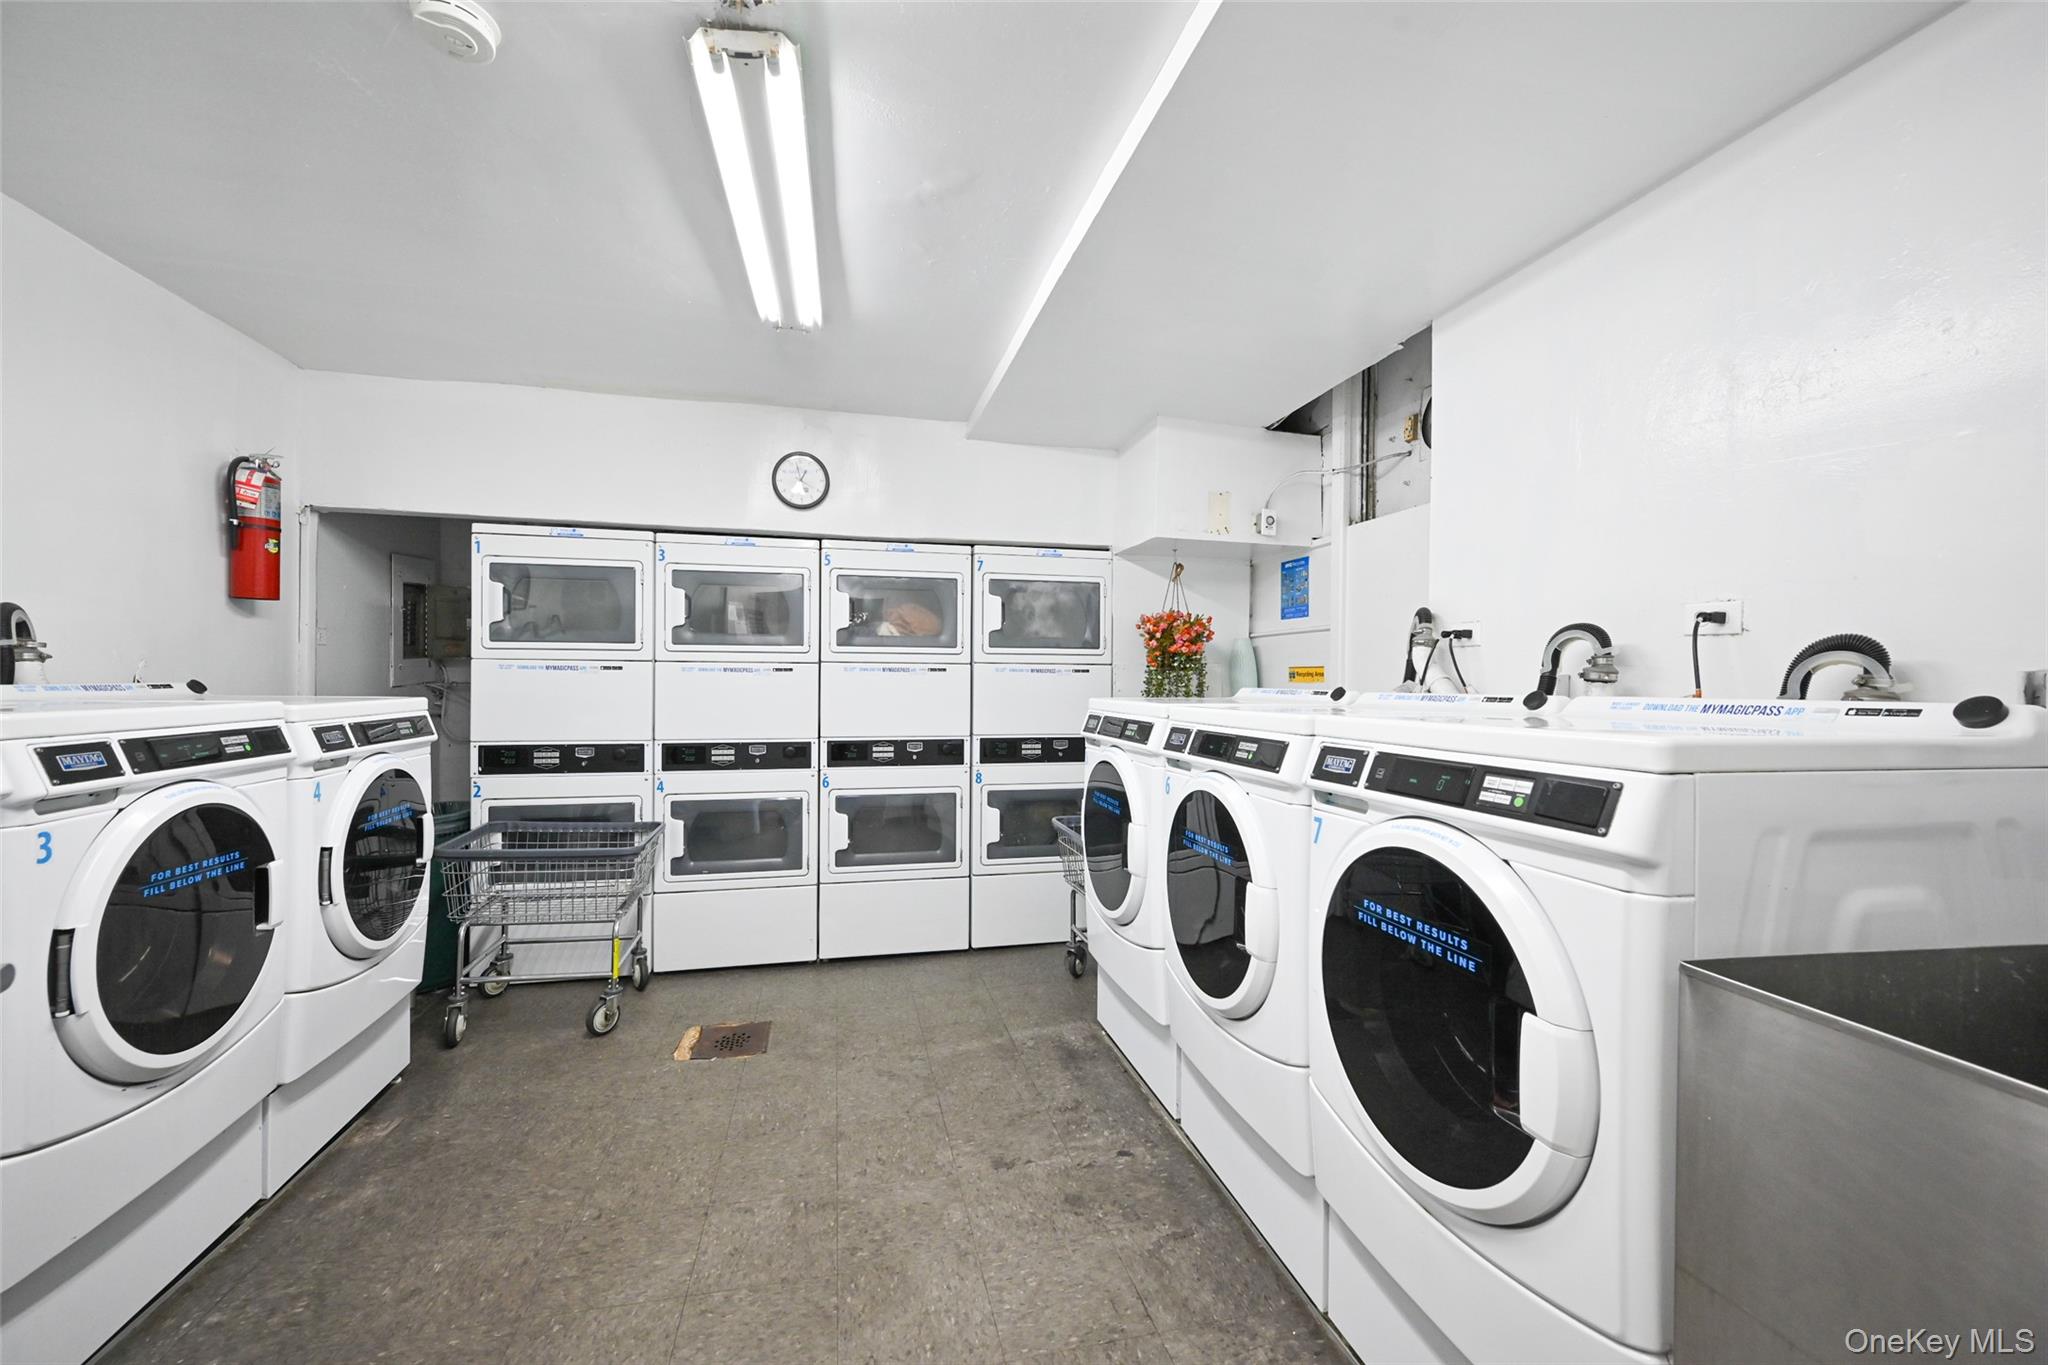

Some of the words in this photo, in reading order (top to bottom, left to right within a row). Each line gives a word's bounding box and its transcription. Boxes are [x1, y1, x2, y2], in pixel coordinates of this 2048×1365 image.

[475, 540, 481, 554] 1
[658, 549, 666, 562] 3
[824, 554, 830, 566] 5
[976, 560, 984, 572] 7
[1643, 704, 1683, 712] DOWNLOAD
[1684, 704, 1699, 712] THE
[1700, 704, 1784, 716] MYMAGICPASS
[1784, 707, 1806, 716] APP
[62, 754, 102, 765] MAYTAG
[1326, 756, 1353, 768] MAYTAG
[822, 776, 830, 788] 6
[975, 772, 982, 784] 8
[1165, 776, 1171, 794] 6
[313, 780, 322, 802] 4
[472, 784, 482, 798] 2
[656, 781, 664, 793] 4
[1313, 816, 1324, 844] 7
[36, 831, 53, 865] 3
[150, 870, 171, 882] FOR
[175, 862, 199, 875] BEST
[202, 851, 240, 868] RESULTS
[144, 885, 165, 898] FILL
[170, 874, 202, 890] BELOW
[206, 868, 222, 879] THE
[226, 862, 246, 873] LINE
[1363, 899, 1383, 914] FOR
[1386, 908, 1412, 926] BEST
[1416, 921, 1468, 950] RESULTS
[1358, 912, 1378, 928] FILL
[1381, 922, 1416, 945] BELOW
[1420, 939, 1442, 957] THE
[1447, 951, 1476, 973] LINE
